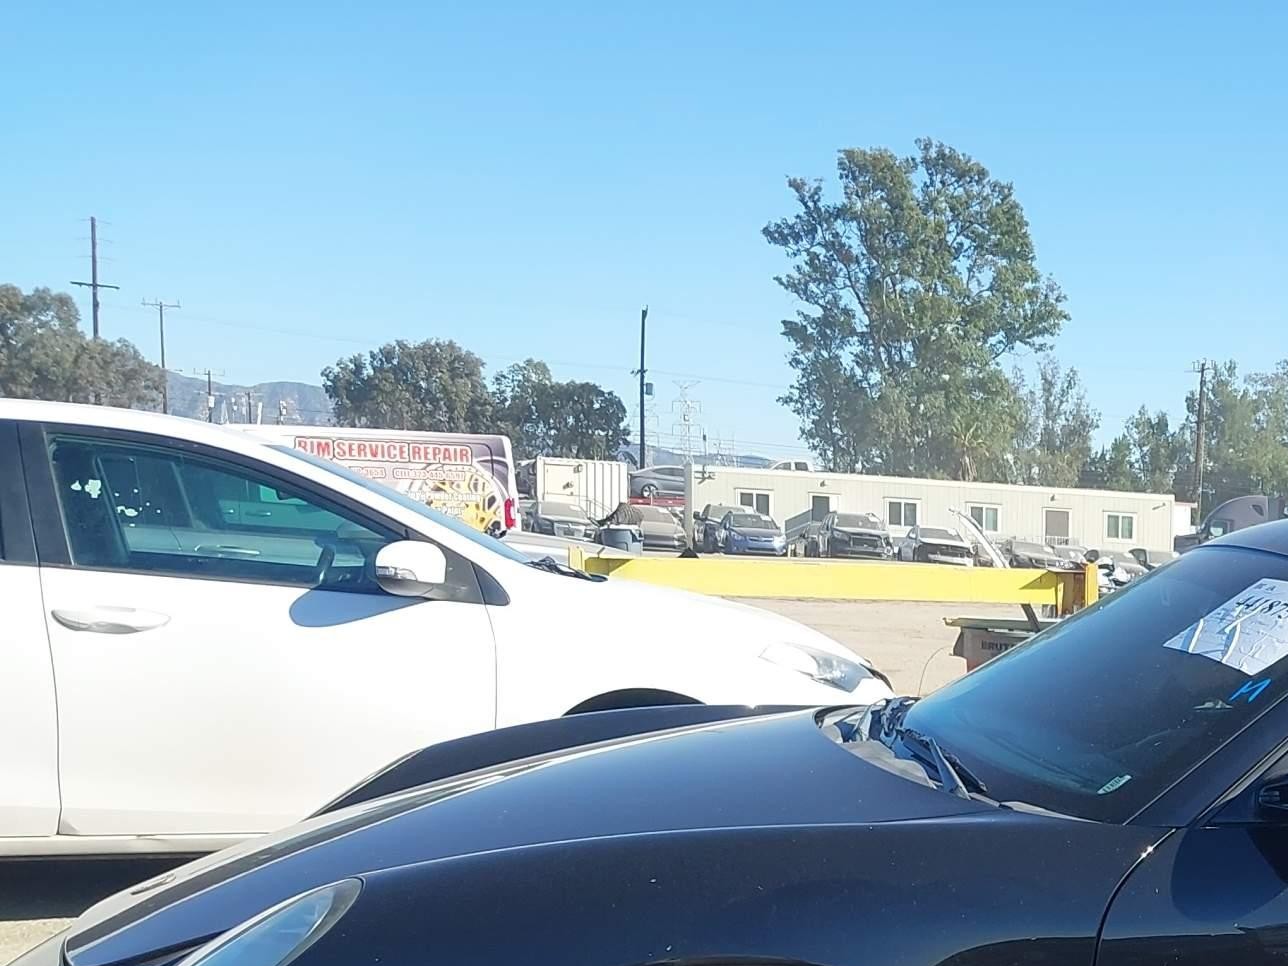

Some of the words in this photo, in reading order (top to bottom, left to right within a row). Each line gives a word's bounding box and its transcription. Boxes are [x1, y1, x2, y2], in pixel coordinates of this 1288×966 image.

[297, 440, 331, 457] RIM
[336, 442, 407, 460] SERVICE
[411, 445, 470, 463] REPAIR
